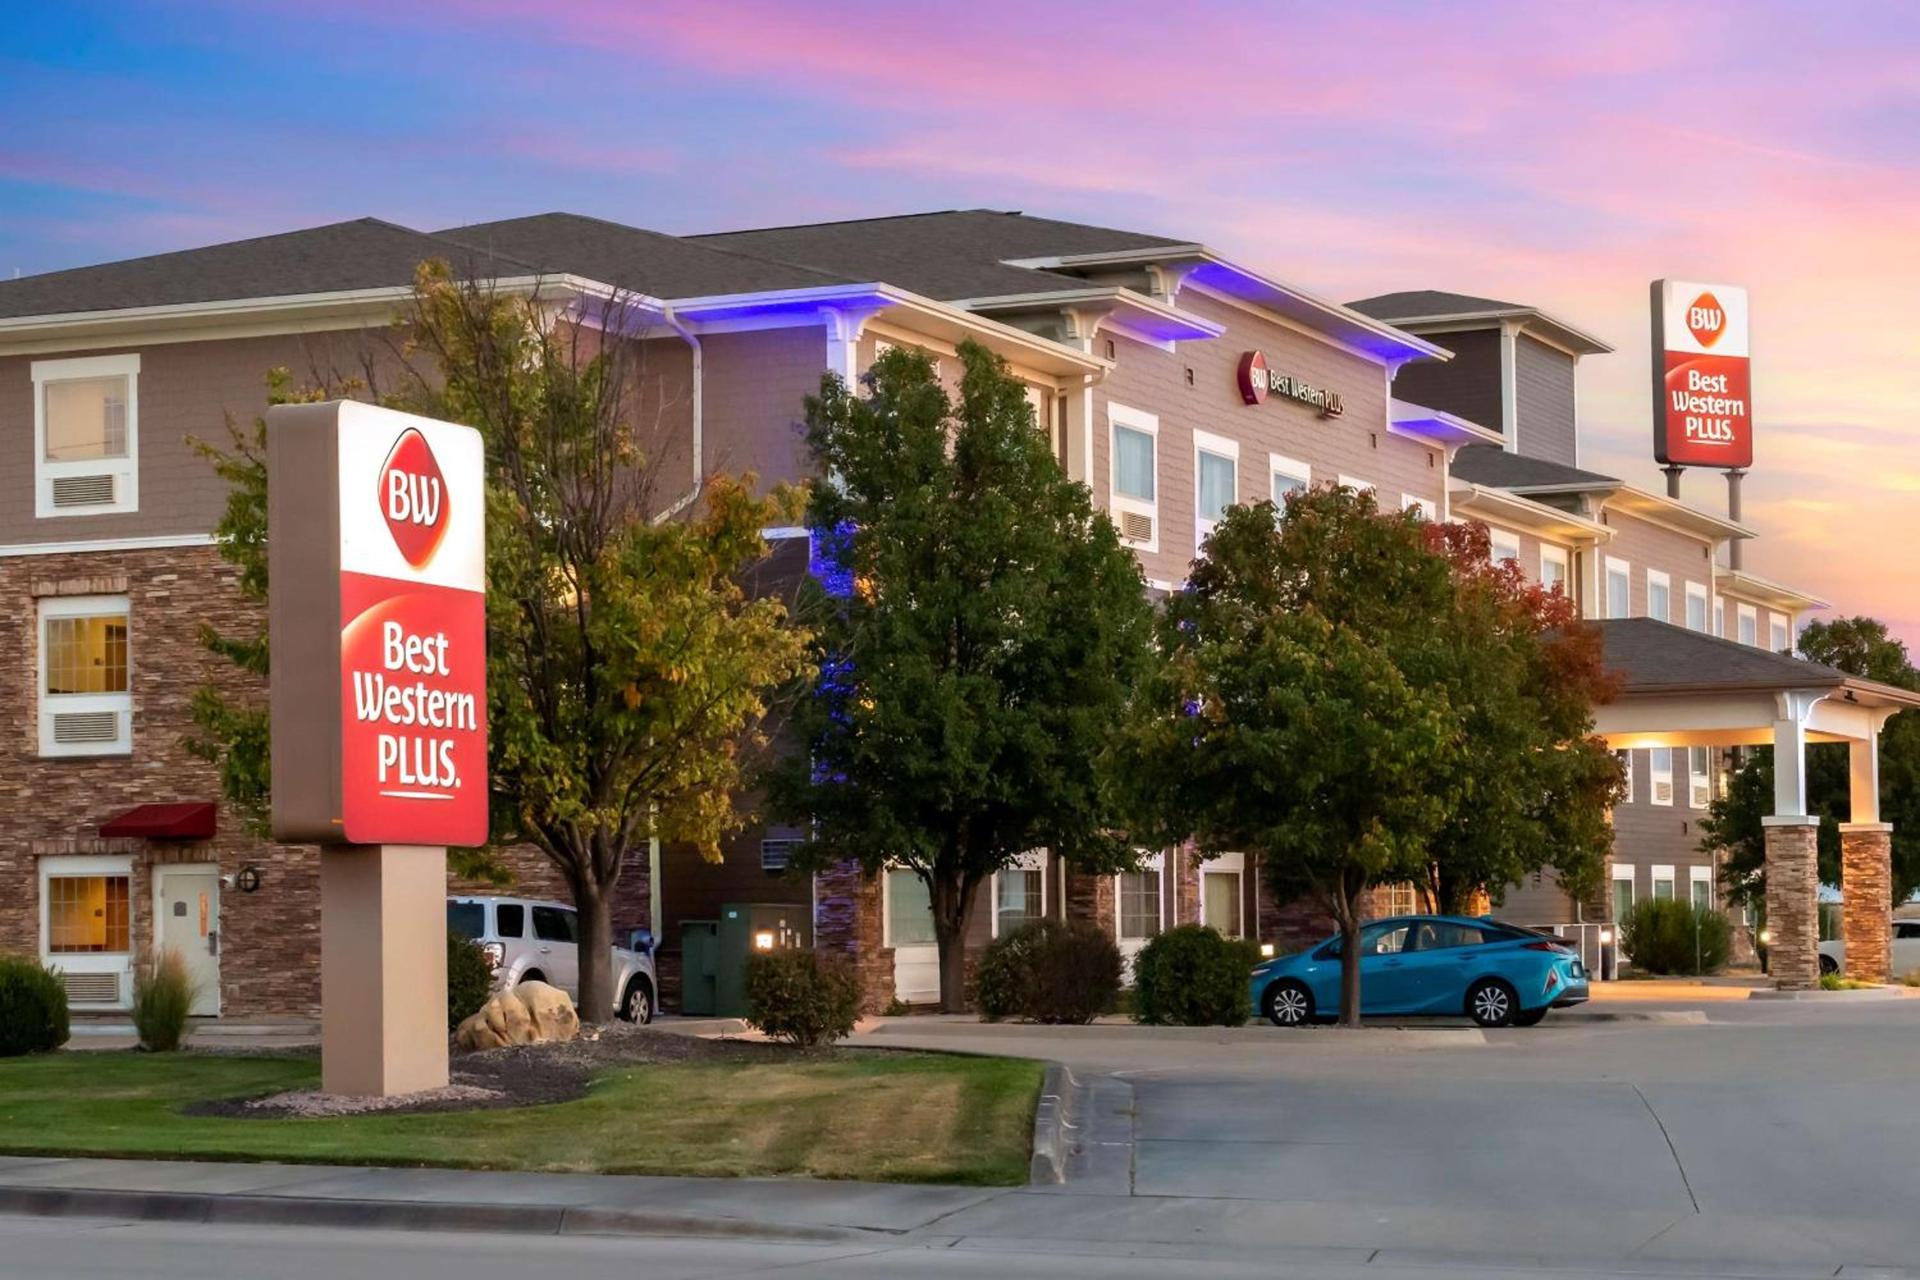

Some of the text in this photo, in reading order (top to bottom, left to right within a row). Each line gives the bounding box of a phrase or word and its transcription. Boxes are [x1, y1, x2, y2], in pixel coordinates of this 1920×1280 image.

[1691, 308, 1722, 331] BW
[1252, 368, 1266, 389] BW
[1270, 370, 1344, 414] Best Western PLUS
[1688, 370, 1728, 393] Best
[1672, 390, 1744, 416] Western
[388, 469, 440, 527] BW
[383, 621, 449, 676] Best
[353, 671, 477, 730] Western
